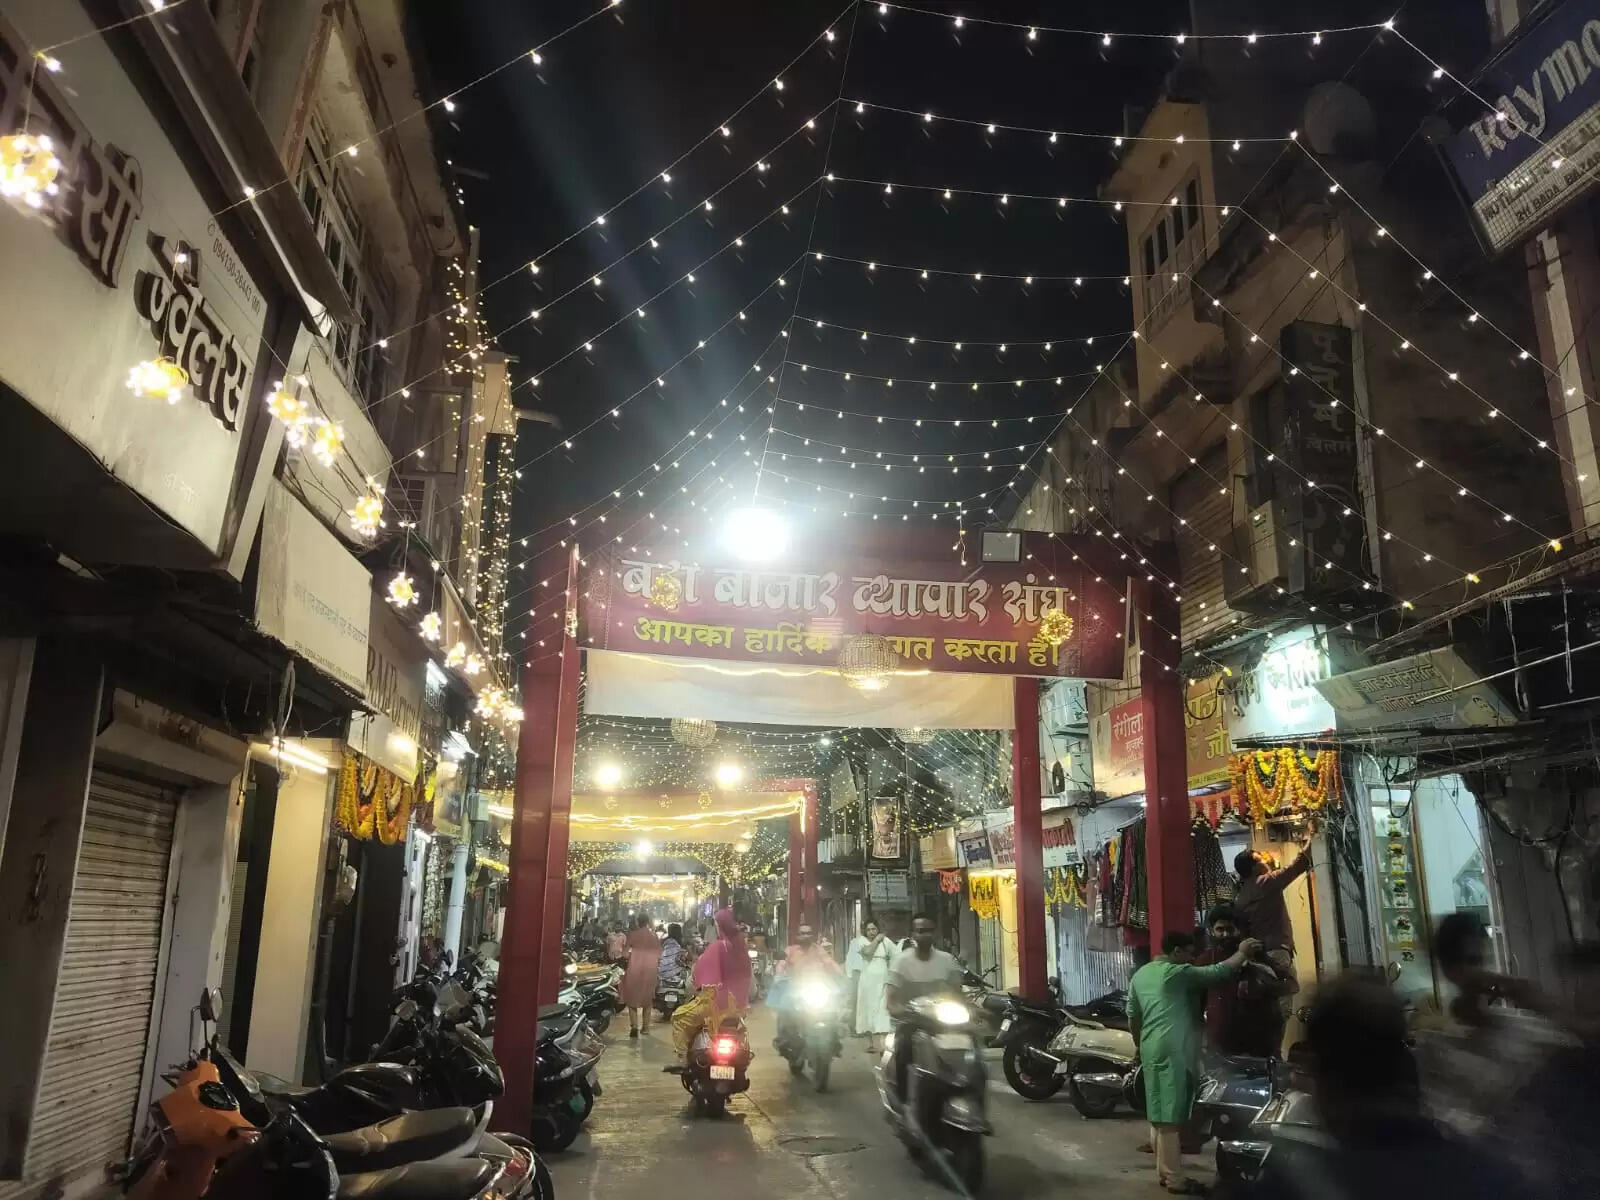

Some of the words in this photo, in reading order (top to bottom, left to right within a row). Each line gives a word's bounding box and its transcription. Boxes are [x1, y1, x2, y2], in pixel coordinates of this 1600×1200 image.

[852, 574, 991, 625] व्यापार
[634, 617, 734, 649] आपका
[744, 621, 837, 656] हार्दिक
[944, 639, 1018, 664] करता
